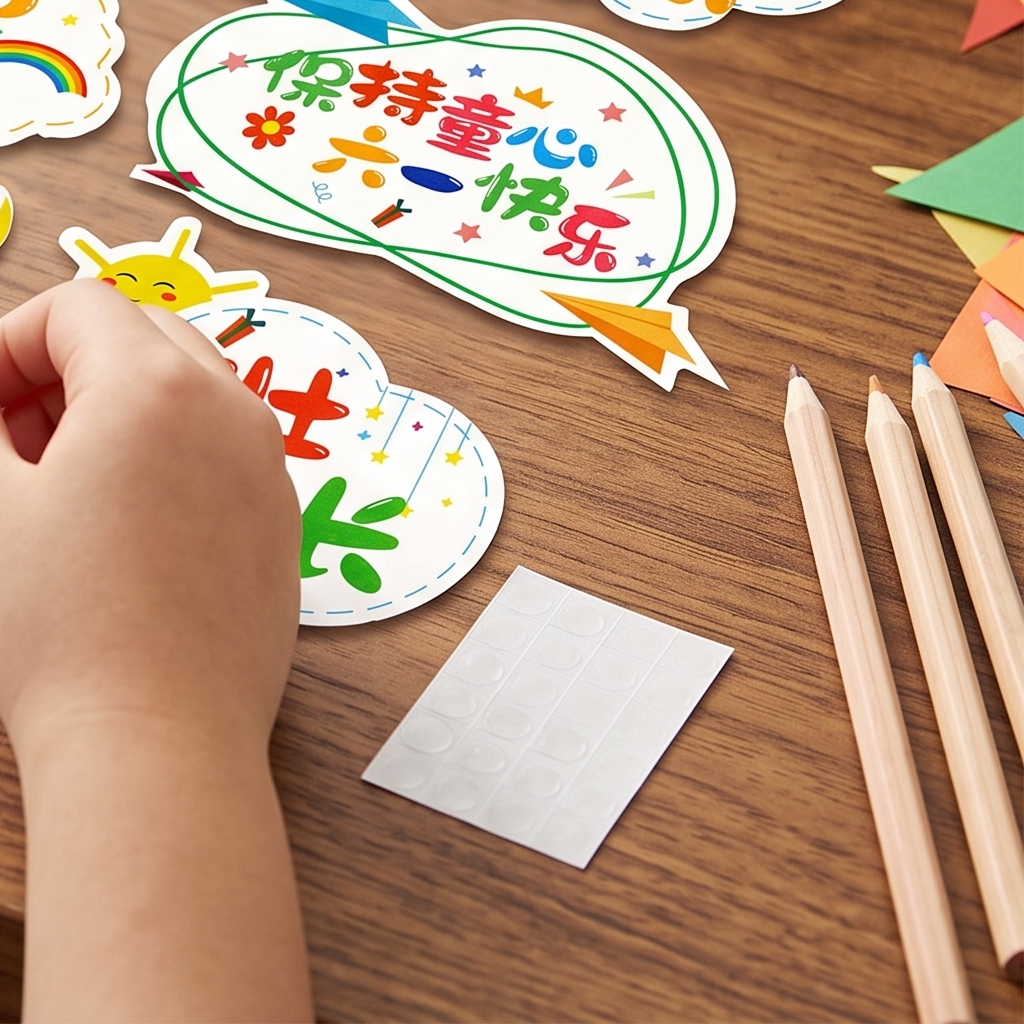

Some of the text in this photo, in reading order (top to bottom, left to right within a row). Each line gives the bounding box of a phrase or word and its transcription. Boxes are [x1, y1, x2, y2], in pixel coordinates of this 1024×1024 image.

[262, 49, 598, 170] 保持童心
[312, 125, 631, 273] 六一快乐
